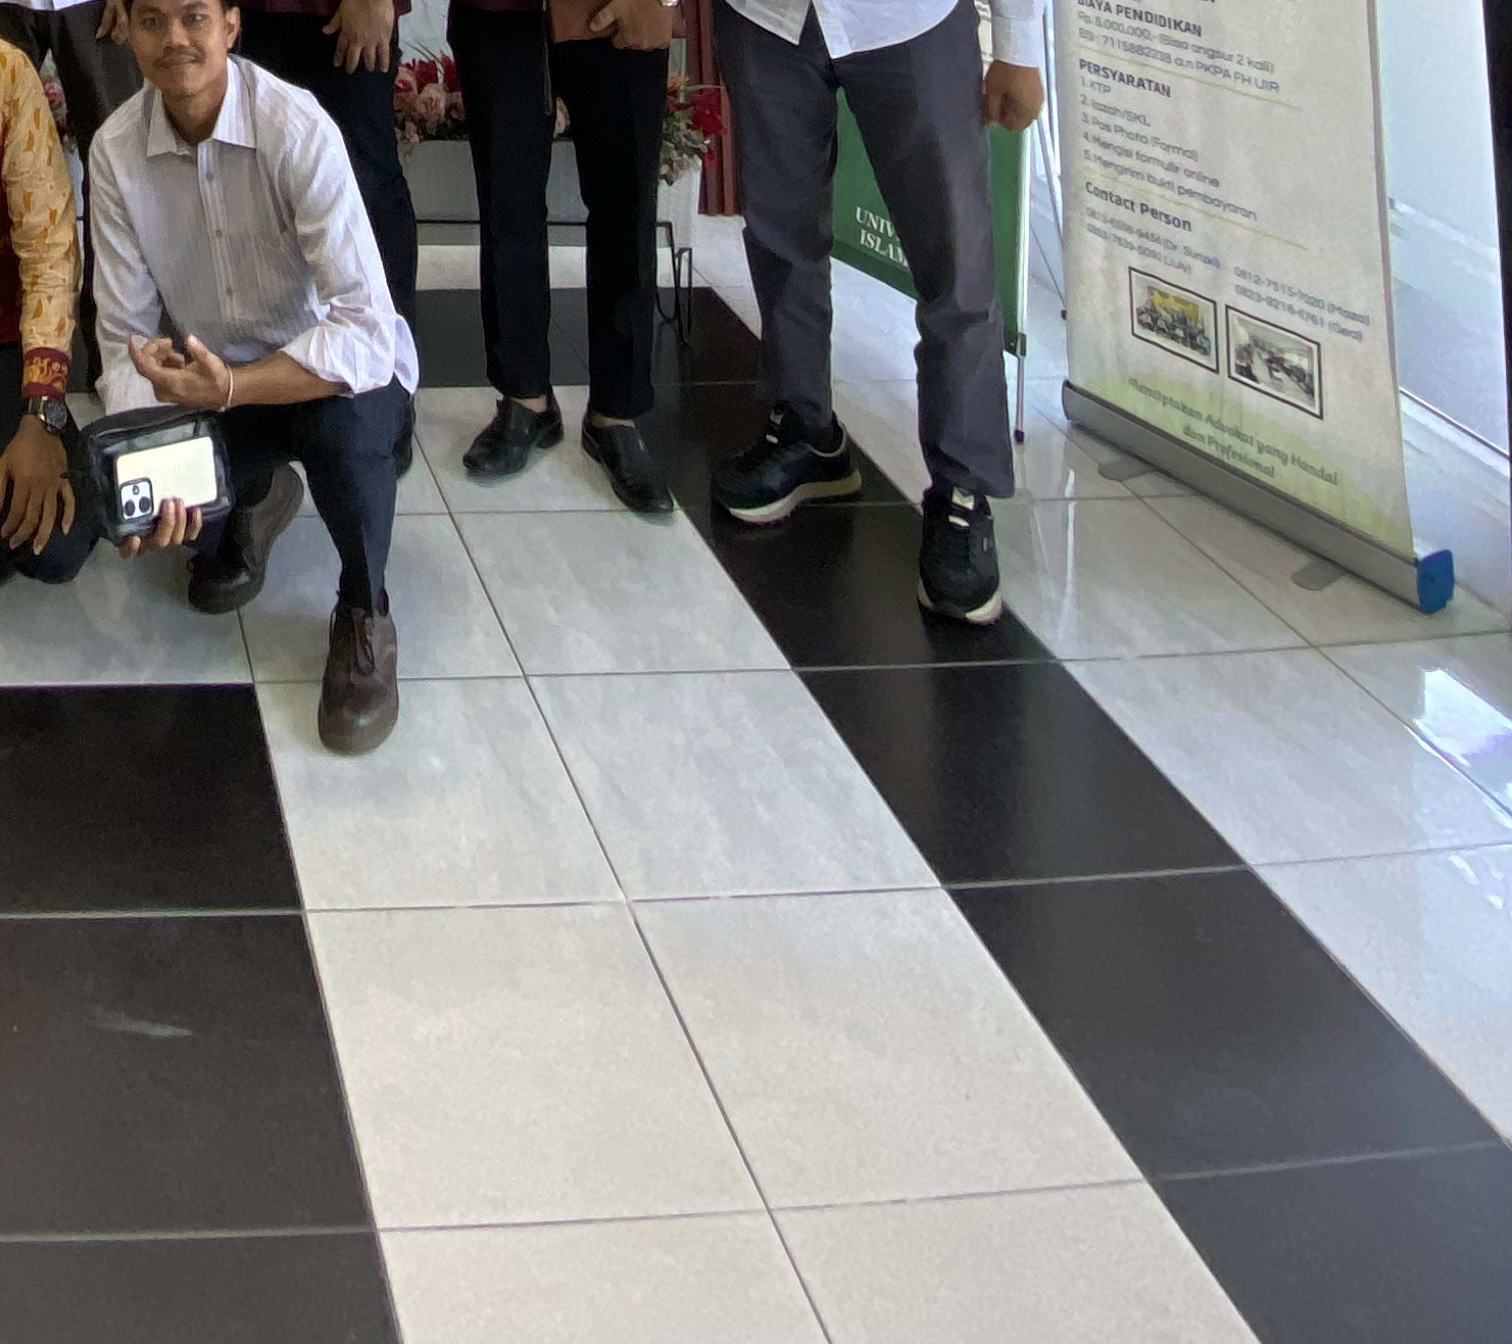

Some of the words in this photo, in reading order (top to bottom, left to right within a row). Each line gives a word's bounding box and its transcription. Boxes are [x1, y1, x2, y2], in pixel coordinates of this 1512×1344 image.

[1115, 4, 1202, 38] PENDIDIKAN
[1078, 58, 1172, 99] PERSYARATAN
[1085, 181, 1136, 213] Contact
[1139, 202, 1193, 233] Person
